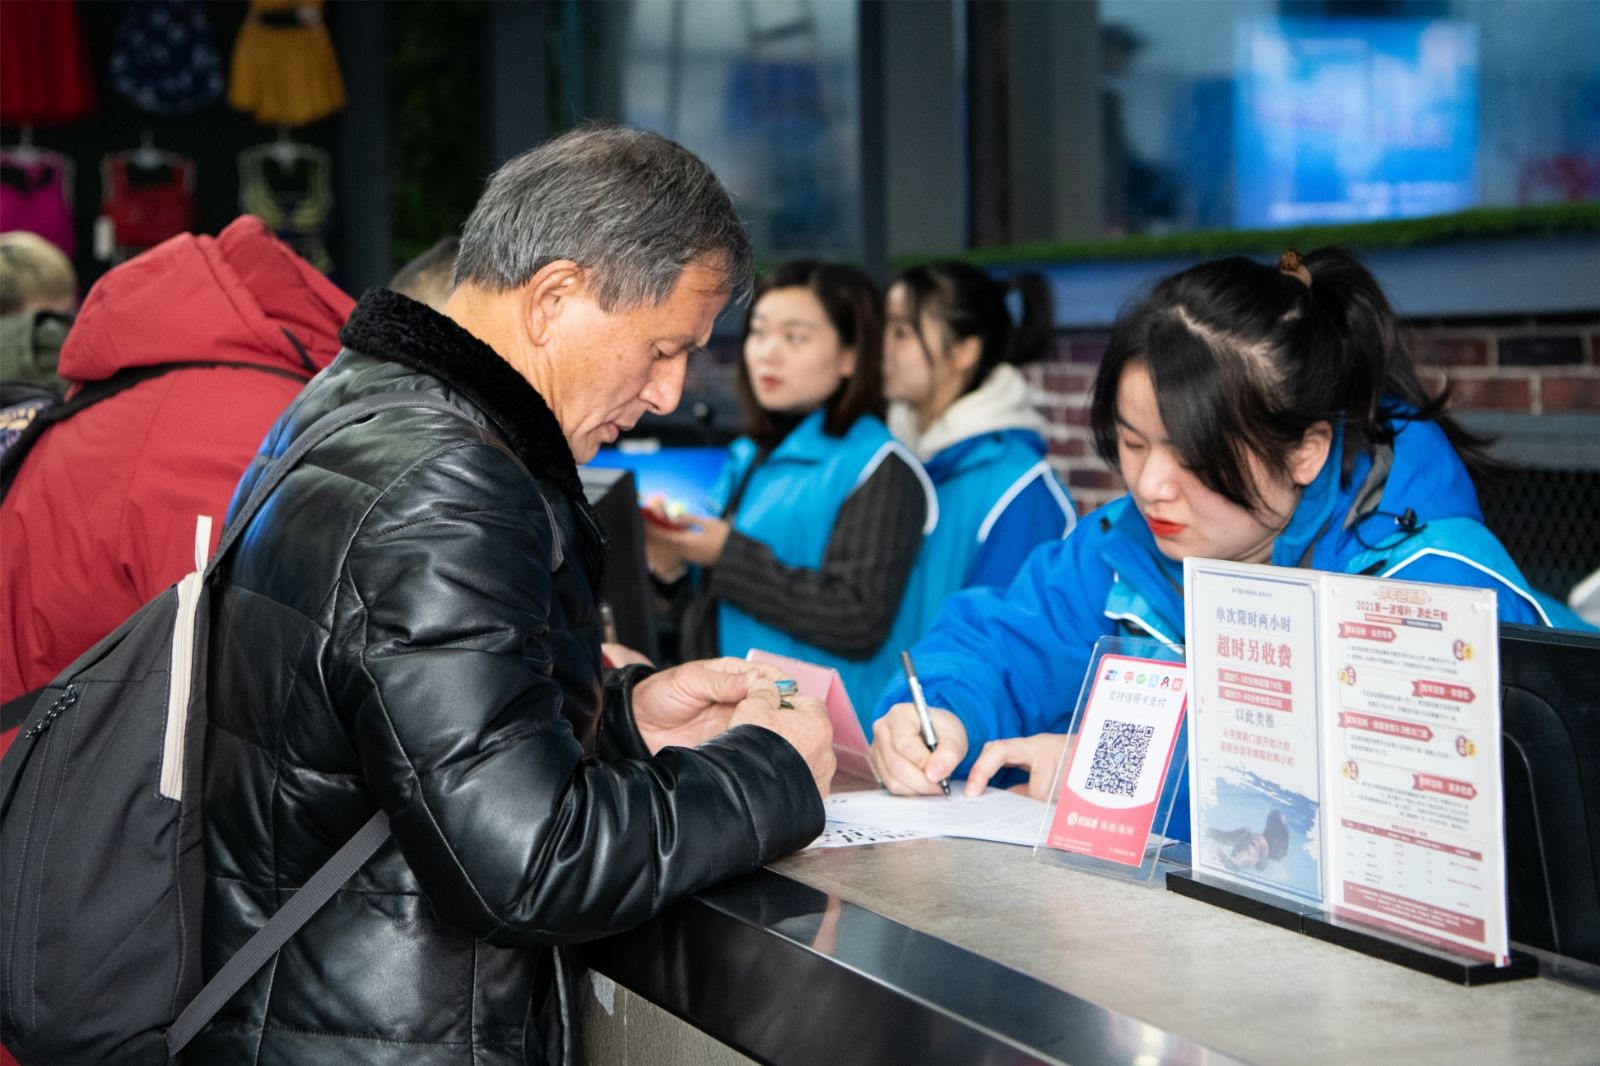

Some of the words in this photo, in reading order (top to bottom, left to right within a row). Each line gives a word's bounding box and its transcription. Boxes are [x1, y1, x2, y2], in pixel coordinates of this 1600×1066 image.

[1216, 606, 1291, 632] 单次限时两小时
[1216, 633, 1292, 668] 超时另收费
[1109, 690, 1167, 709] 支持信用卡支付
[1235, 708, 1275, 728] 以此类推
